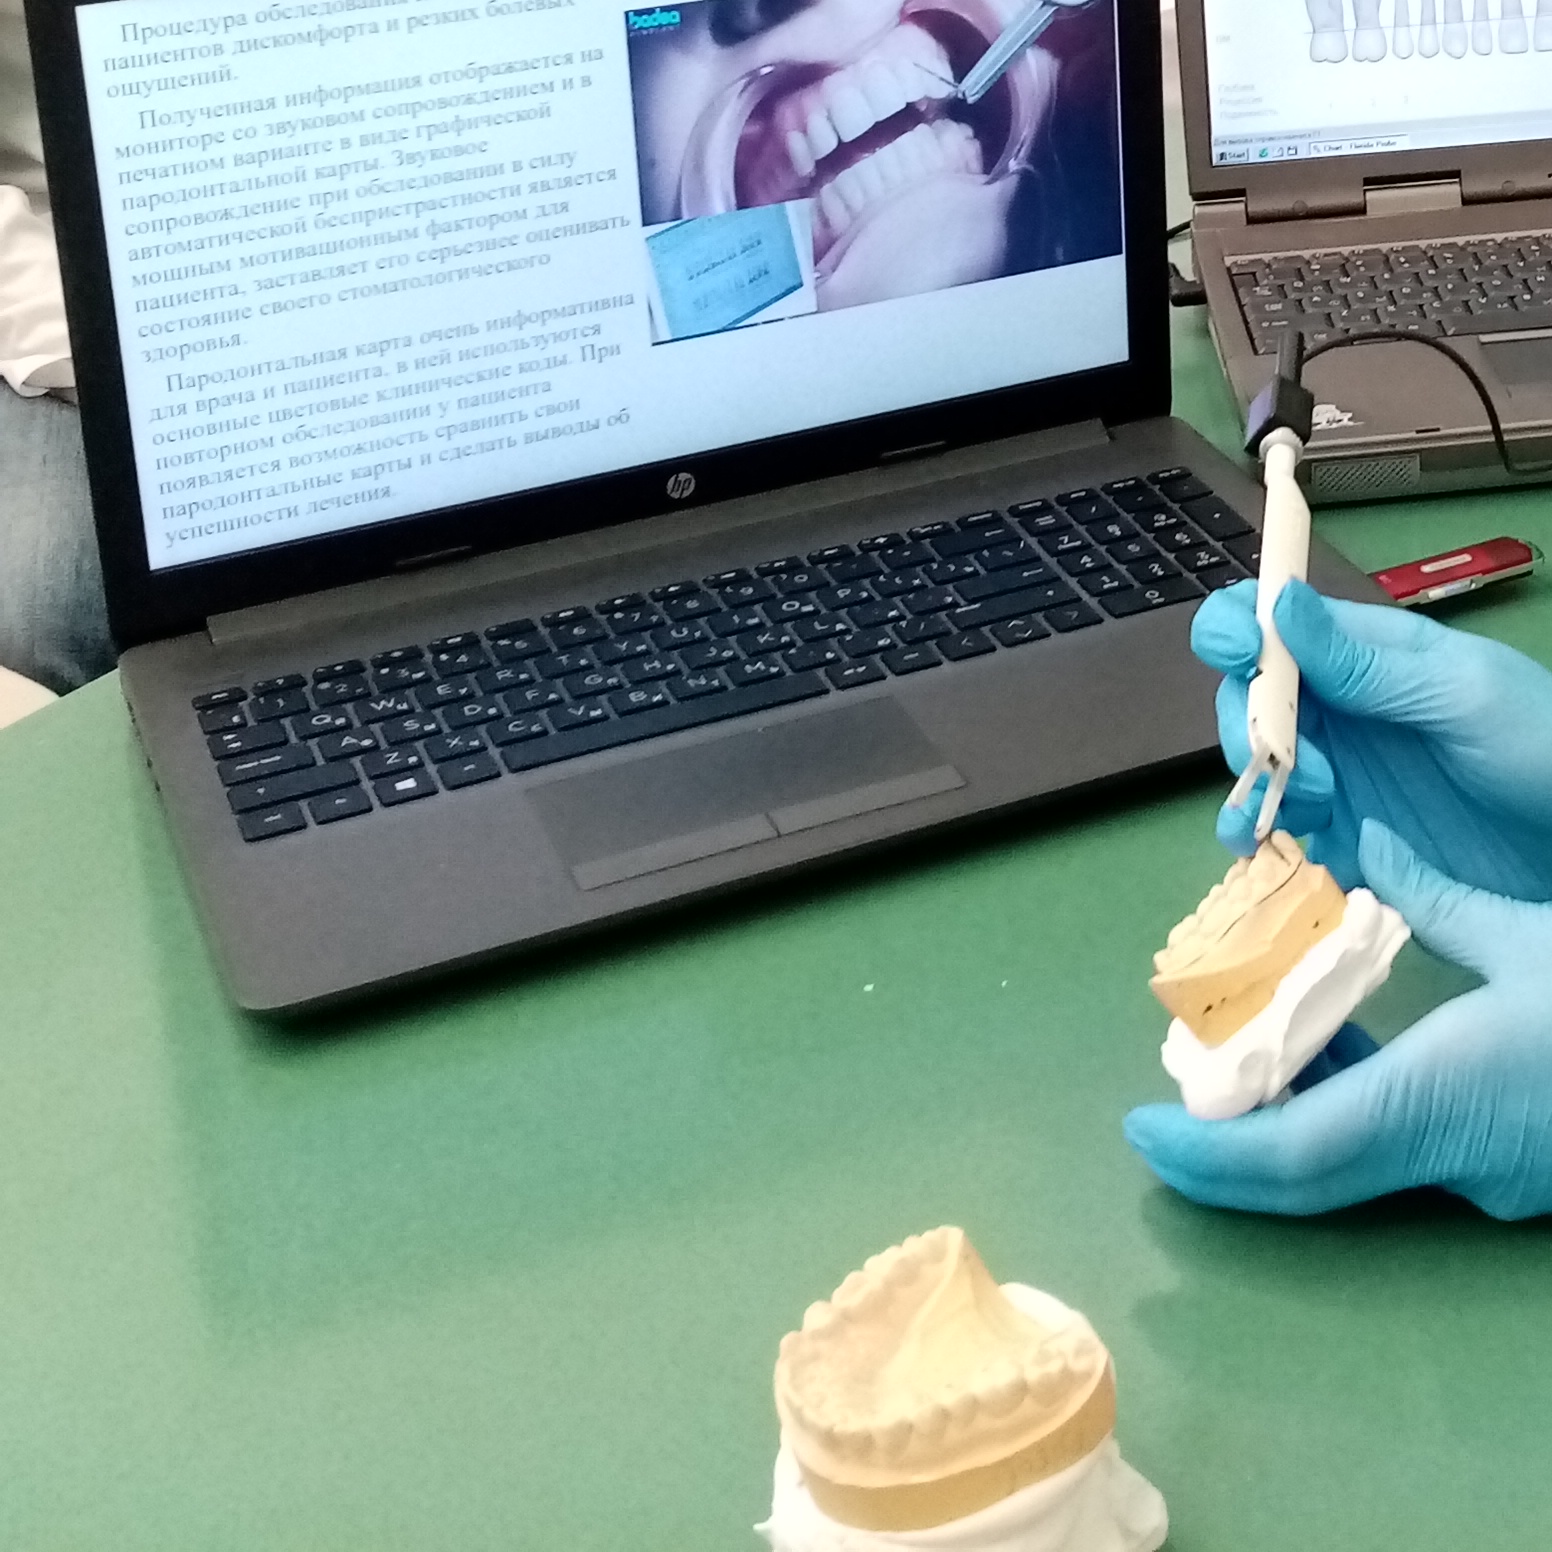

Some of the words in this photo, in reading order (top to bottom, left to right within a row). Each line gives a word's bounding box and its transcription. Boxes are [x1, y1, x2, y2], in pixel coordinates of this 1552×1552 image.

[103, 43, 225, 73] пациентов
[232, 21, 380, 55] дискомфорта
[406, 7, 479, 34] резких
[120, 13, 248, 45] Процедура
[138, 97, 277, 130] Полученная
[285, 75, 422, 108] информация
[428, 52, 574, 85] отображается
[580, 48, 604, 63] на
[115, 131, 225, 158] мониторе
[232, 126, 257, 141] со
[118, 156, 225, 185] печатном
[233, 140, 333, 169] варианте
[359, 128, 409, 147] виде
[416, 101, 551, 142] графической
[394, 140, 488, 168] Звуковое
[309, 188, 349, 209] при
[355, 162, 505, 198] обследовании
[528, 152, 574, 170] силу
[527, 168, 617, 194] является
[132, 259, 231, 287] мощным
[425, 208, 528, 241] фактором
[535, 201, 570, 218] для
[253, 260, 368, 292] заставляет
[375, 254, 409, 270] его
[416, 234, 519, 265] серьезнее
[525, 215, 631, 243] оценивать
[137, 306, 252, 338] состояние
[259, 293, 331, 316] своего
[355, 335, 412, 358] карта
[419, 323, 480, 344] очень
[486, 293, 635, 332] информативна
[149, 402, 188, 423] для
[195, 390, 256, 415] врача
[414, 352, 452, 370] ней
[458, 323, 601, 362] используются
[152, 414, 261, 446] основные
[268, 393, 369, 424] цветовые
[376, 365, 512, 403] клинические
[579, 343, 621, 364] При
[155, 436, 274, 471] повторном
[281, 404, 431, 445] обследовании
[457, 381, 552, 410] пациента
[159, 459, 282, 495] появляется
[288, 430, 429, 469] возможность
[435, 410, 529, 441] сравнить
[534, 398, 581, 418] свои
[351, 457, 413, 481] карты
[438, 435, 518, 462] сделать
[524, 418, 600, 445] выводы
[606, 407, 631, 427] об
[667, 472, 696, 499] hp
[165, 504, 300, 549] успешности
